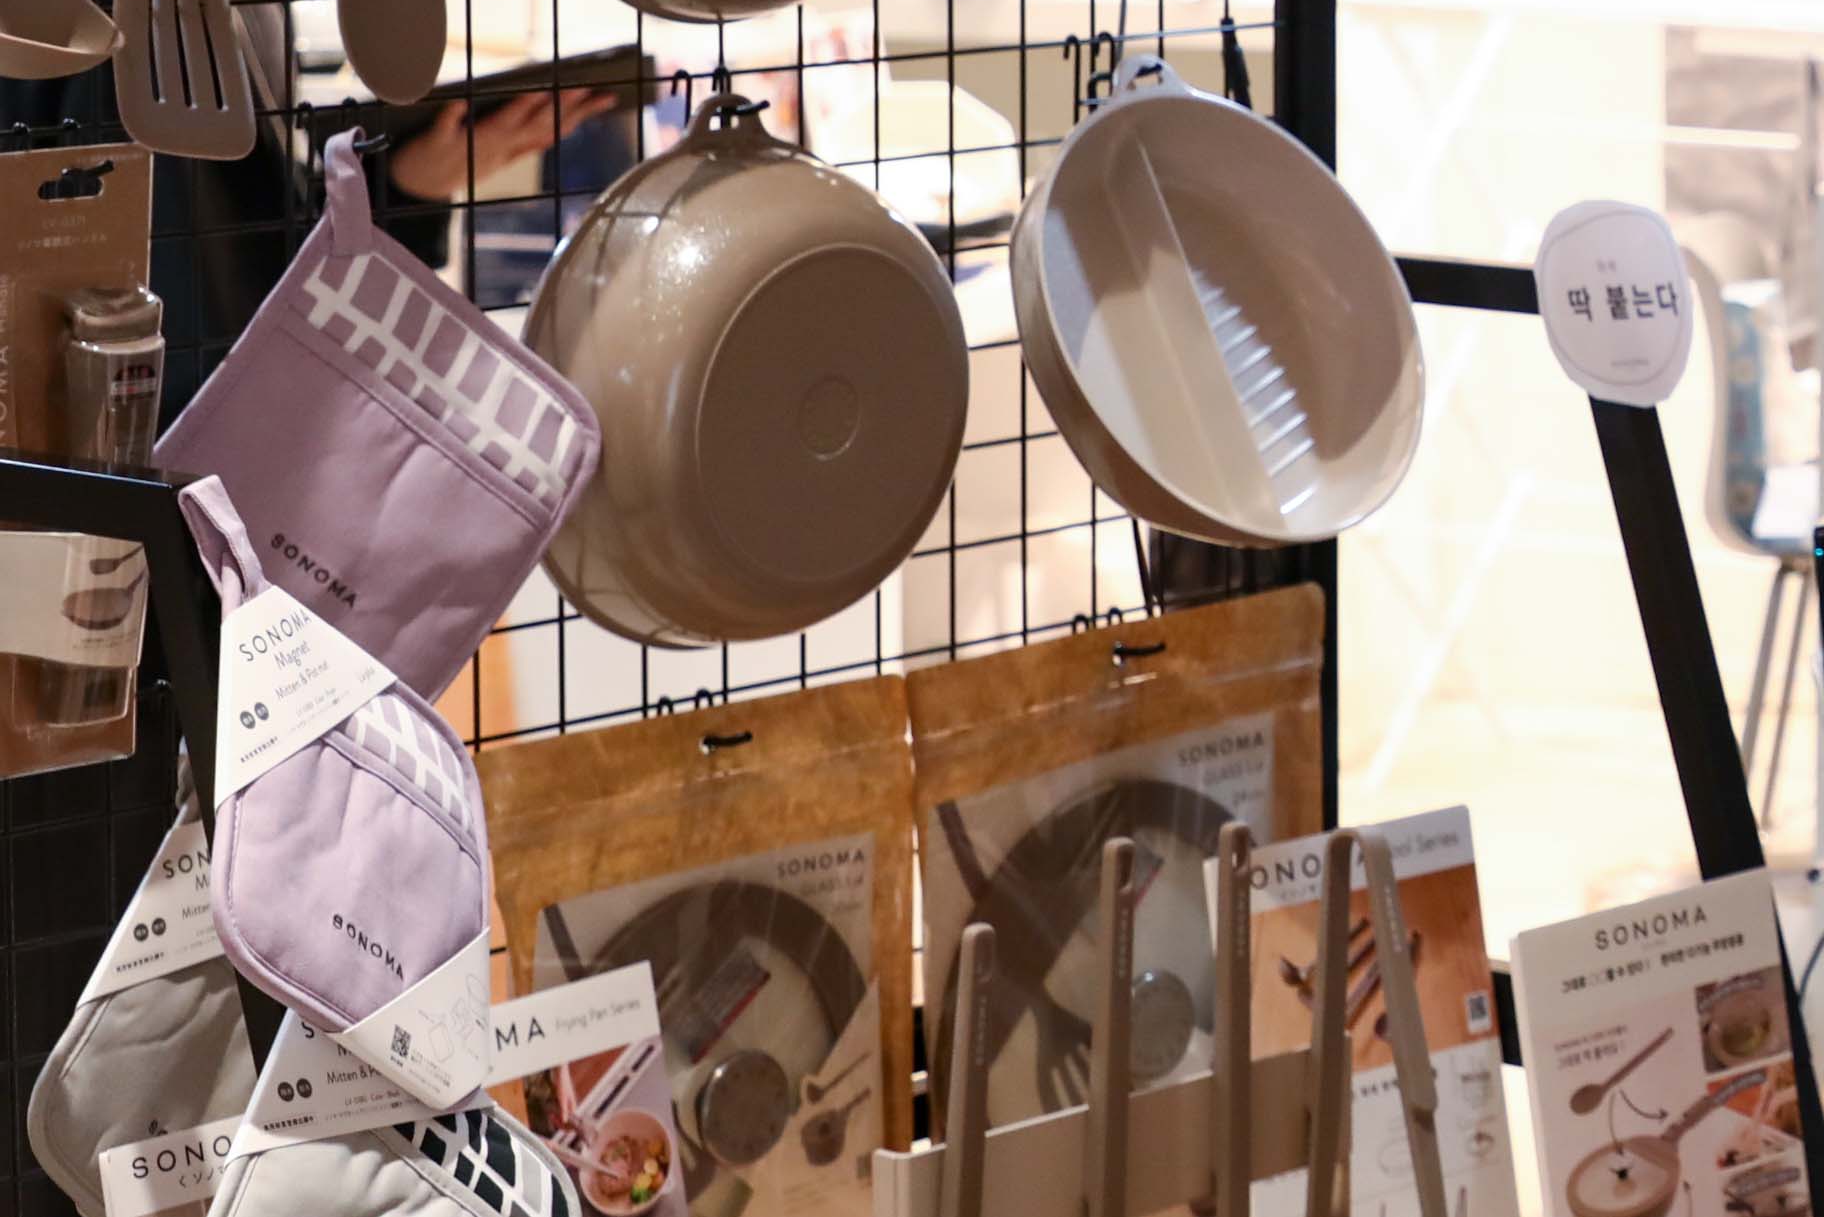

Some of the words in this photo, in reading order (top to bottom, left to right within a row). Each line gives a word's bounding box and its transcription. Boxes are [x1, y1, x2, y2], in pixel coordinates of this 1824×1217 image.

[270, 532, 358, 609] SONOMA
[239, 609, 312, 662] SONOMA
[274, 640, 310, 670] Magnet
[1177, 731, 1265, 767] SONOMA
[776, 847, 866, 880] SONOMA
[1594, 904, 1709, 952] SONOMA
[332, 913, 404, 982] SONOMA
[554, 1013, 588, 1033] Frying
[588, 1007, 609, 1022] Pan
[610, 998, 642, 1017] Series
[326, 1067, 359, 1086] Mitten
